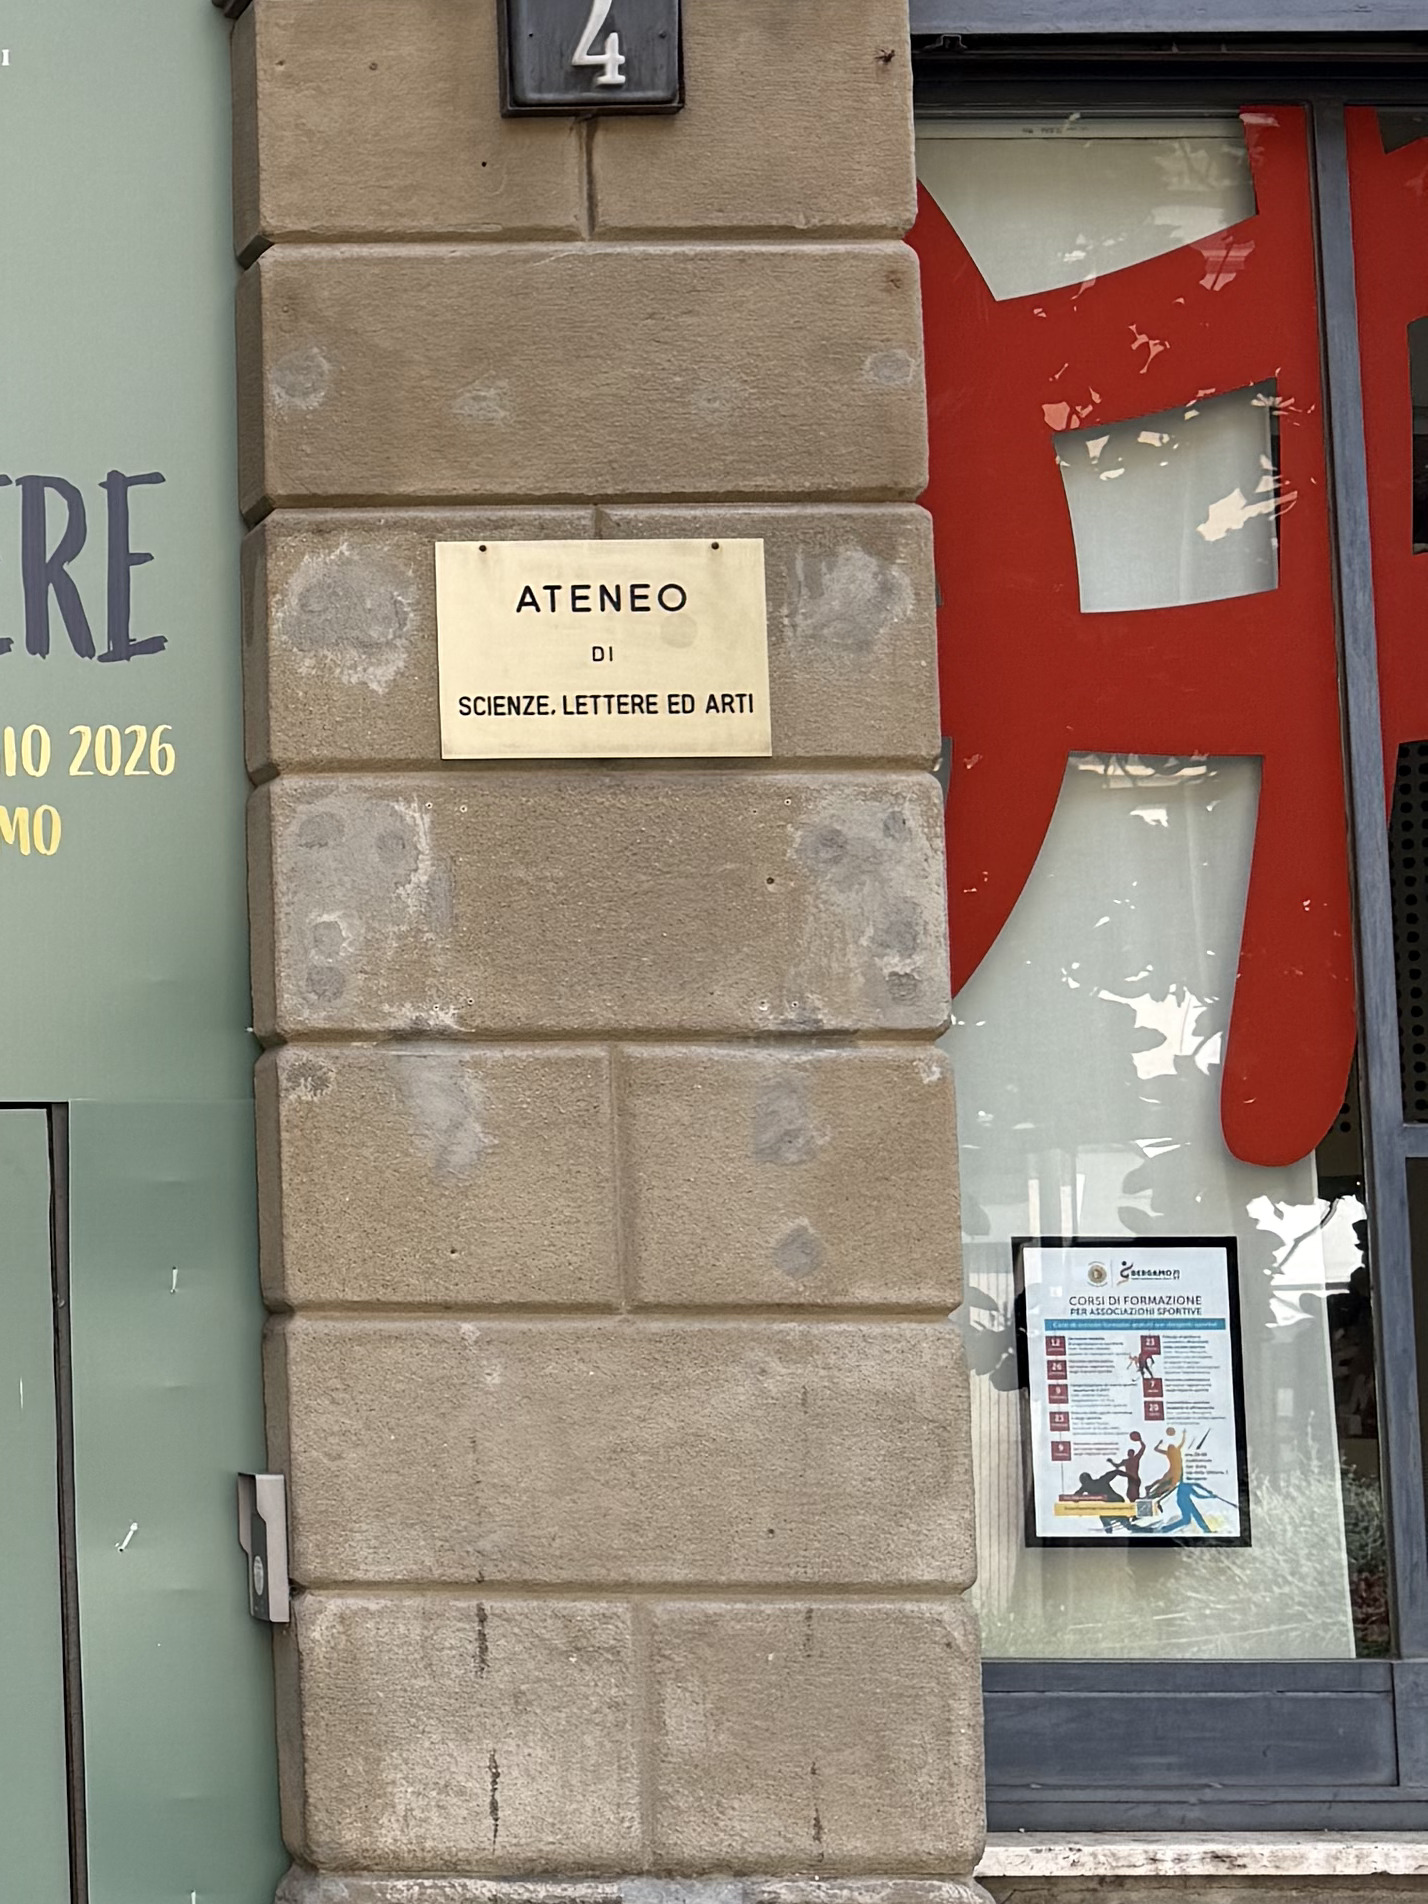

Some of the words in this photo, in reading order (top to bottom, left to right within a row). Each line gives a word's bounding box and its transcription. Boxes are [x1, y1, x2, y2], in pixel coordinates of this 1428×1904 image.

[516, 584, 687, 613] ATENEO
[592, 646, 613, 662] DI
[563, 694, 658, 715] LETTERE
[668, 694, 695, 714] ED
[705, 694, 754, 714] ARTI
[68, 724, 177, 777] 2026
[1069, 1296, 1105, 1305] CORSI
[1109, 1297, 1120, 1305] DI
[1124, 1296, 1202, 1305] FORMAZIONE
[1071, 1308, 1087, 1316] PER
